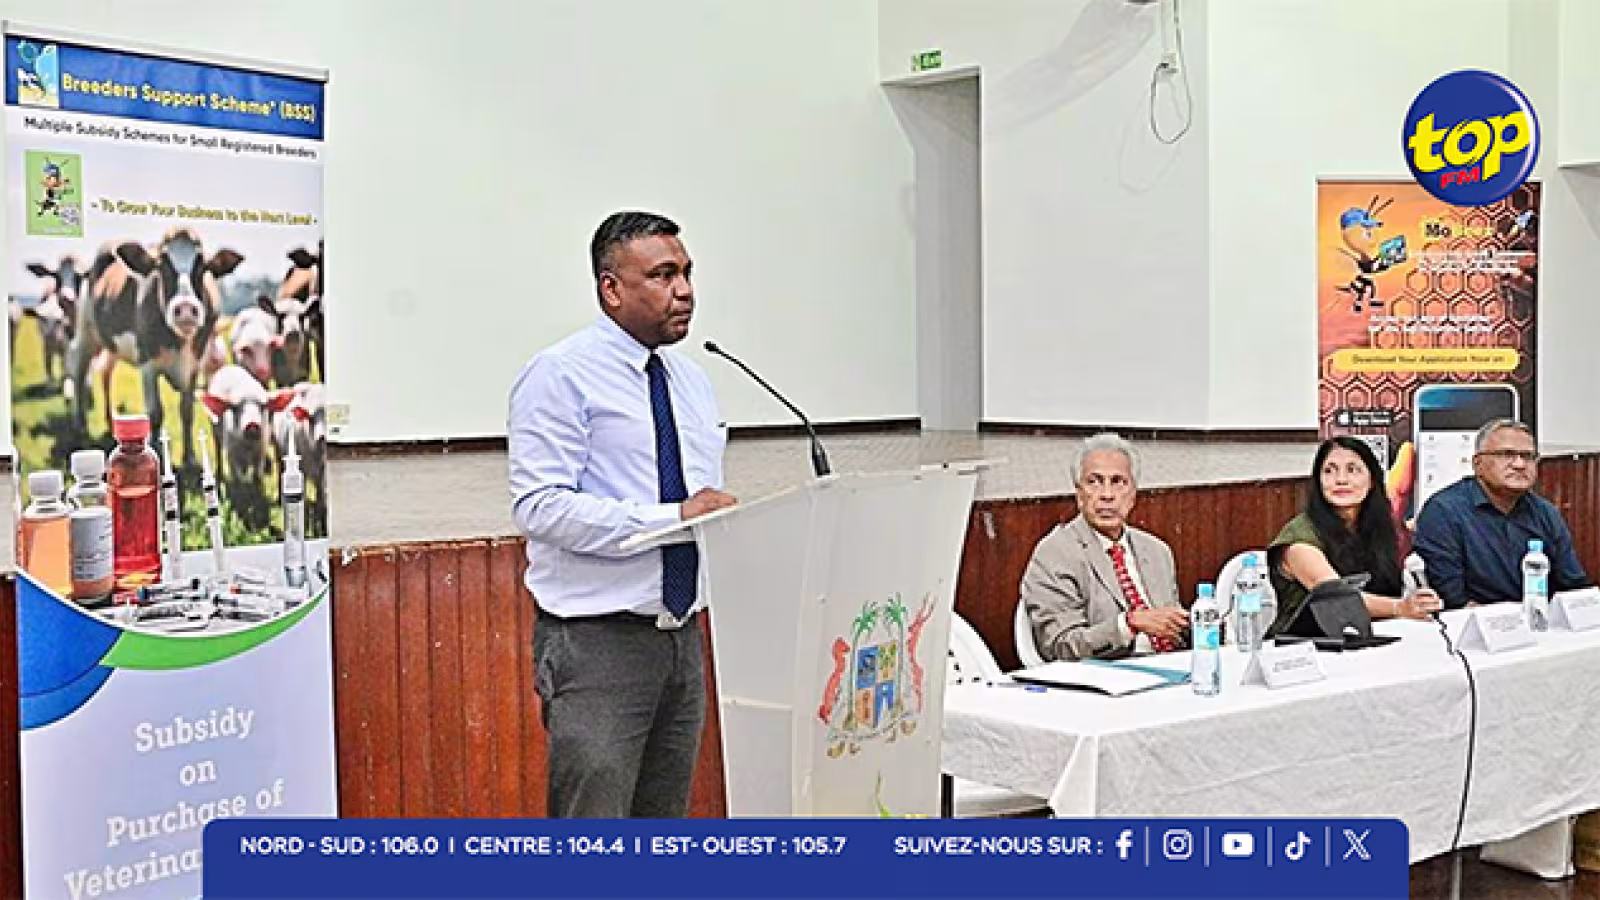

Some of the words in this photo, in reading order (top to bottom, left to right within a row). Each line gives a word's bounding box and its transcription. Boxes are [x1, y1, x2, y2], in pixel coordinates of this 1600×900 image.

[62, 72, 138, 100] Breeders
[141, 83, 206, 107] Support
[24, 116, 74, 134] Multiple
[76, 121, 120, 140] Subsidy
[122, 126, 171, 144] Schemes
[172, 133, 188, 145] for
[189, 133, 219, 149] Small
[220, 138, 275, 154] Registered
[275, 143, 317, 160] Breeders
[99, 197, 115, 213] To
[116, 199, 147, 215] Grow
[147, 201, 175, 217] Your
[134, 706, 255, 753] Subsidy
[178, 760, 217, 787] on
[106, 793, 247, 848] Purchase
[255, 778, 286, 811] of
[64, 847, 202, 900] Veterina
